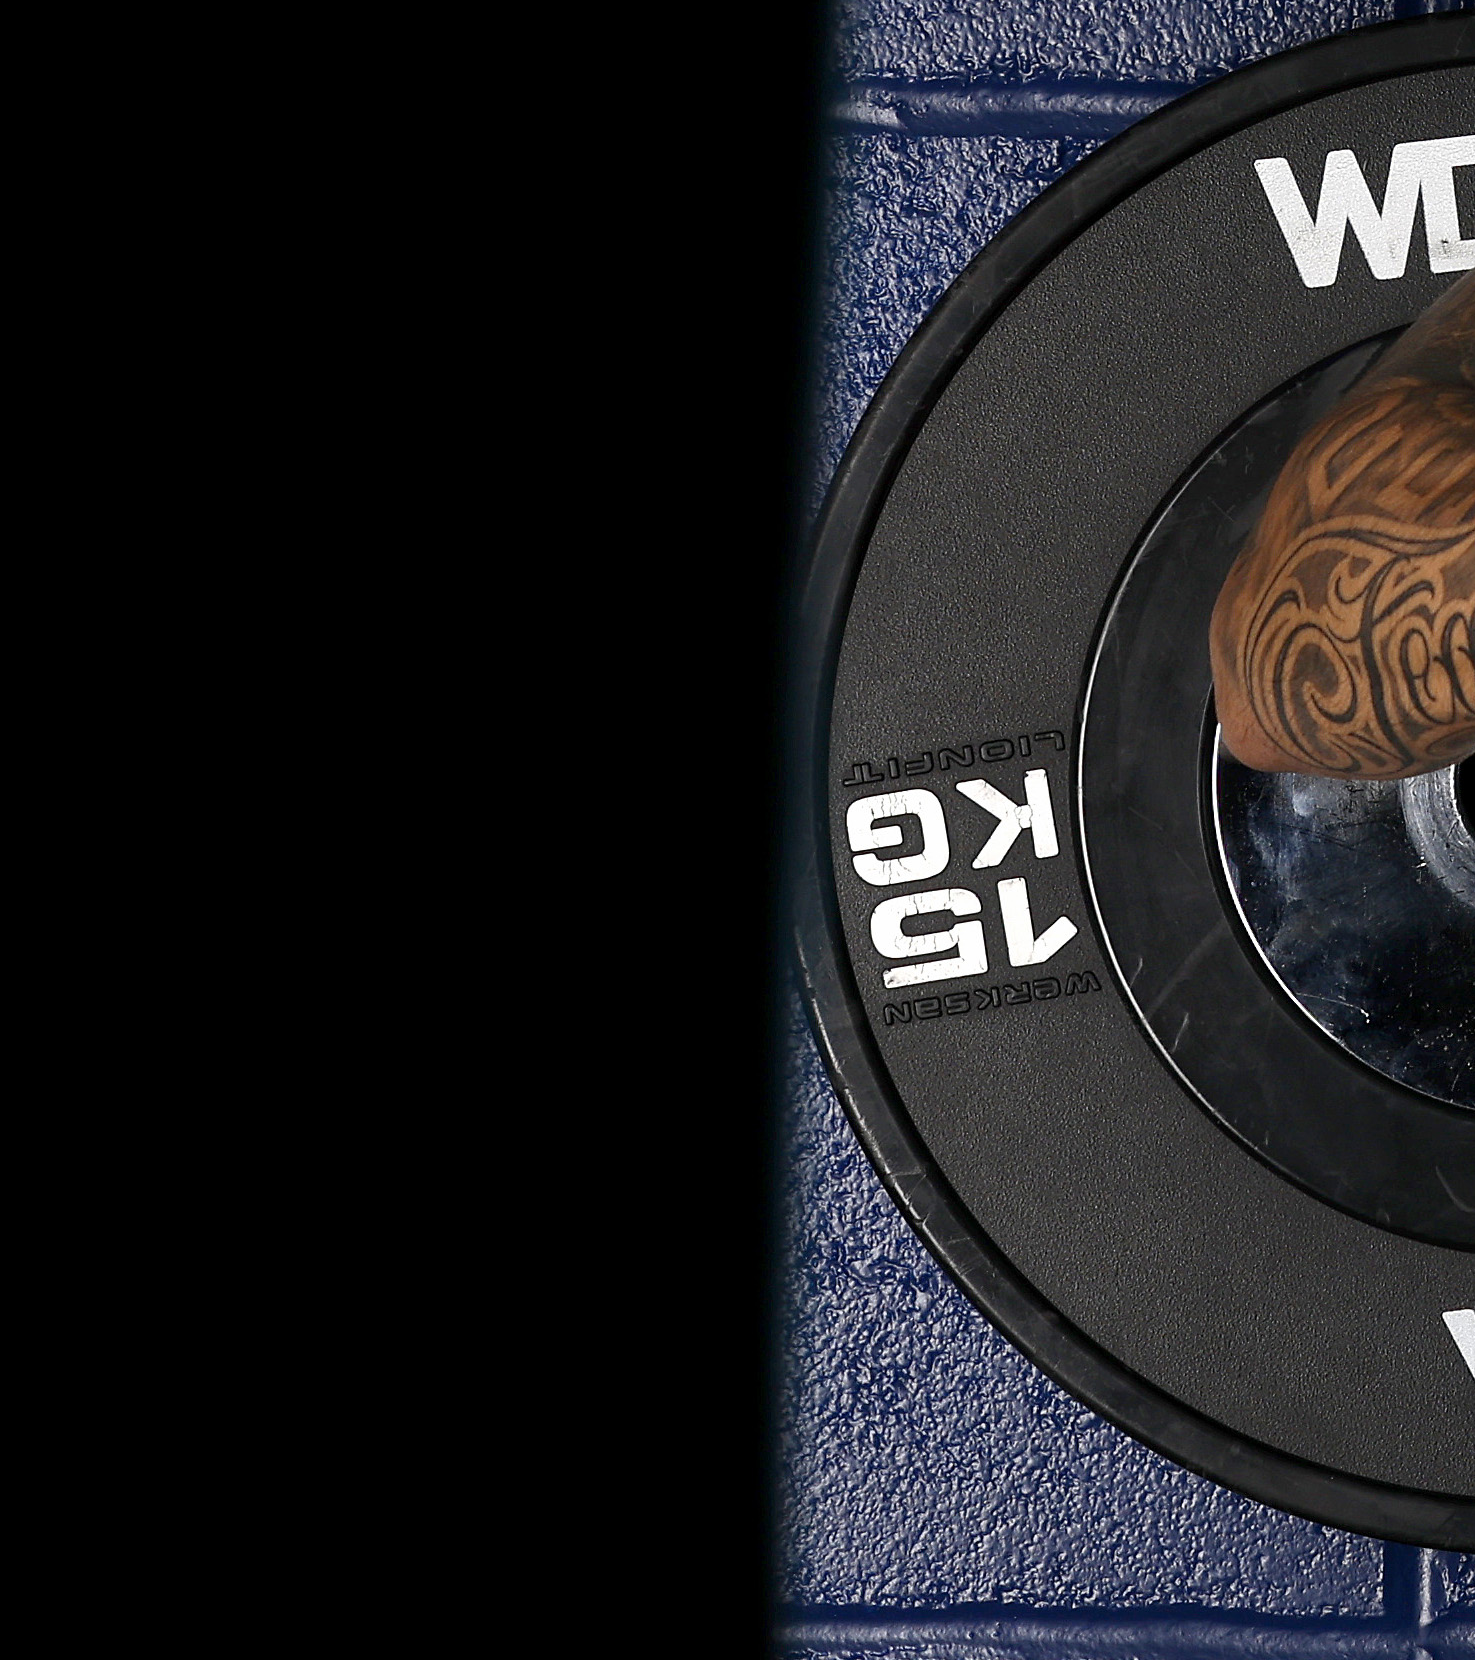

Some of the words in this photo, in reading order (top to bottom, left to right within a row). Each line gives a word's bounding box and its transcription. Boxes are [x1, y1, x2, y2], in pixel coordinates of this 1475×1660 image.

[842, 729, 1067, 787] LIONFIT
[846, 768, 1060, 887] KG
[870, 877, 1079, 989] 15
